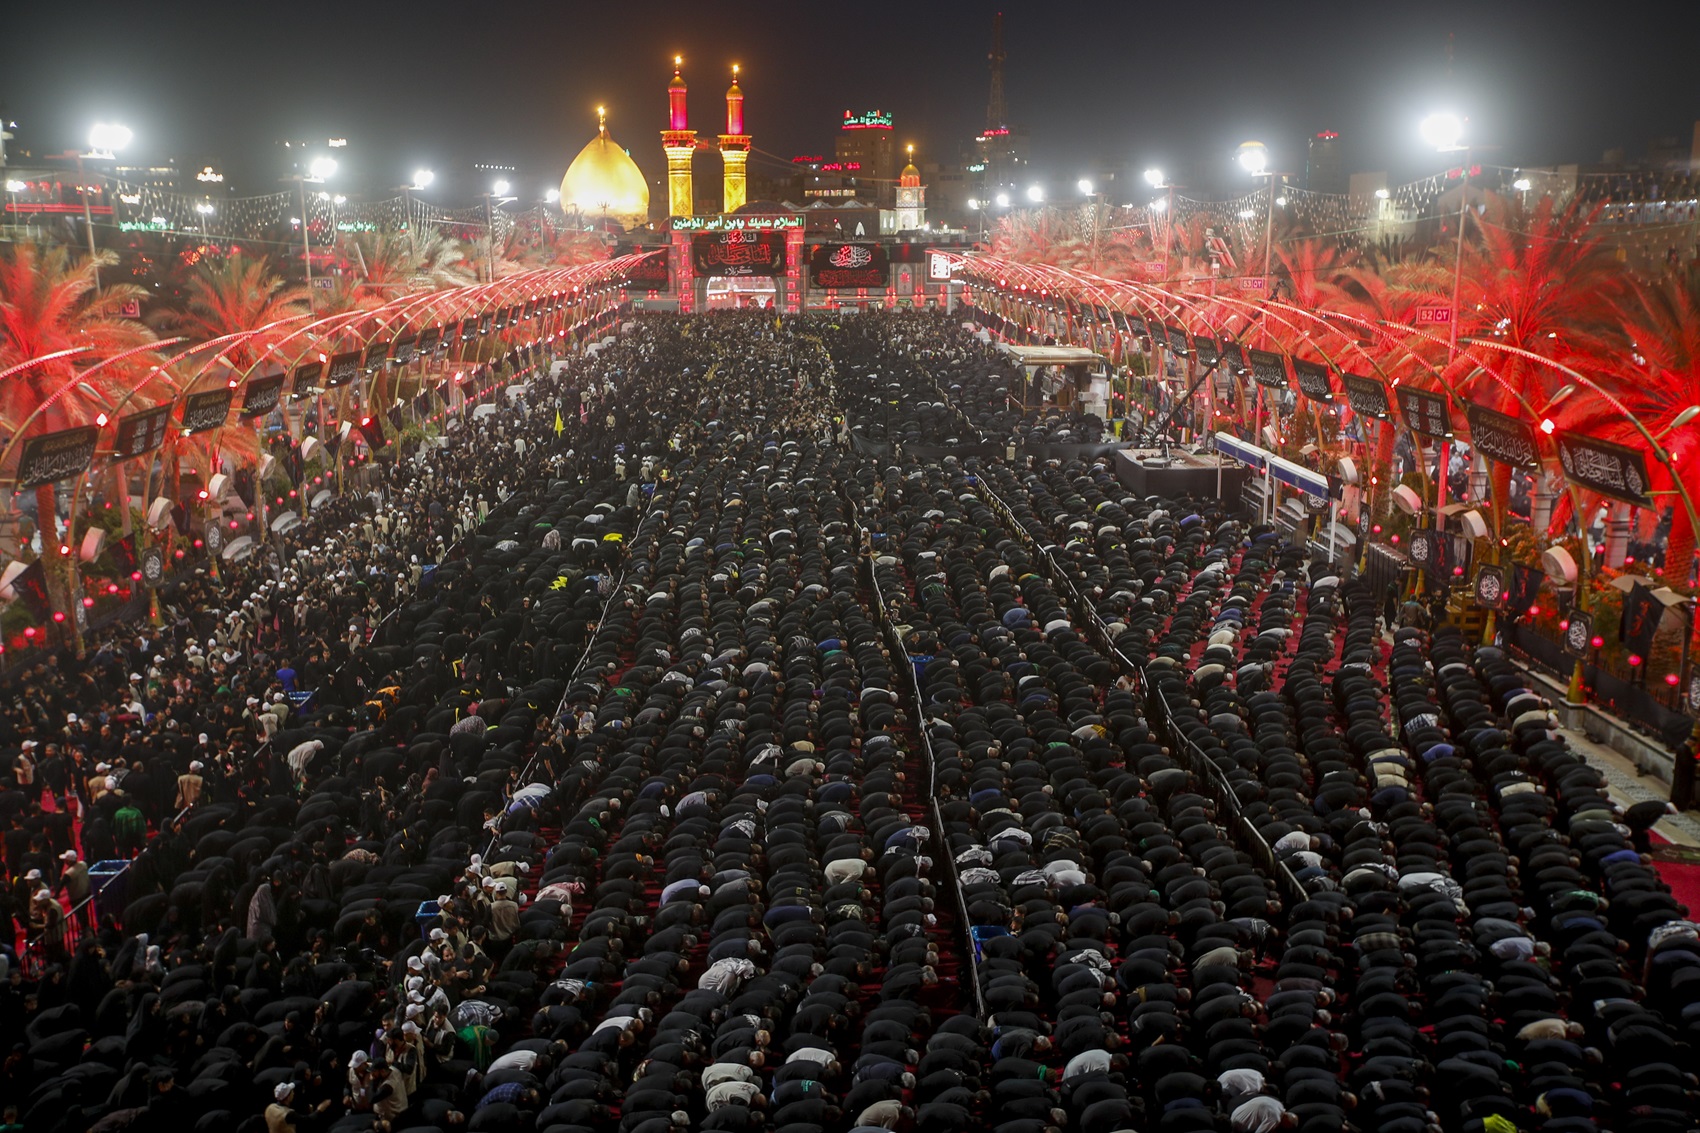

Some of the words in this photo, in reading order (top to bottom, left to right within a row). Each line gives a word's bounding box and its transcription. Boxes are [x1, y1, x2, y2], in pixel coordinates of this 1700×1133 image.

[672, 217, 704, 230] المؤمنين
[705, 215, 723, 230] أمير
[747, 217, 772, 228] عليك
[774, 217, 803, 230] السلام
[1421, 310, 1433, 320] 52
[1436, 310, 1448, 320] ٥٢
